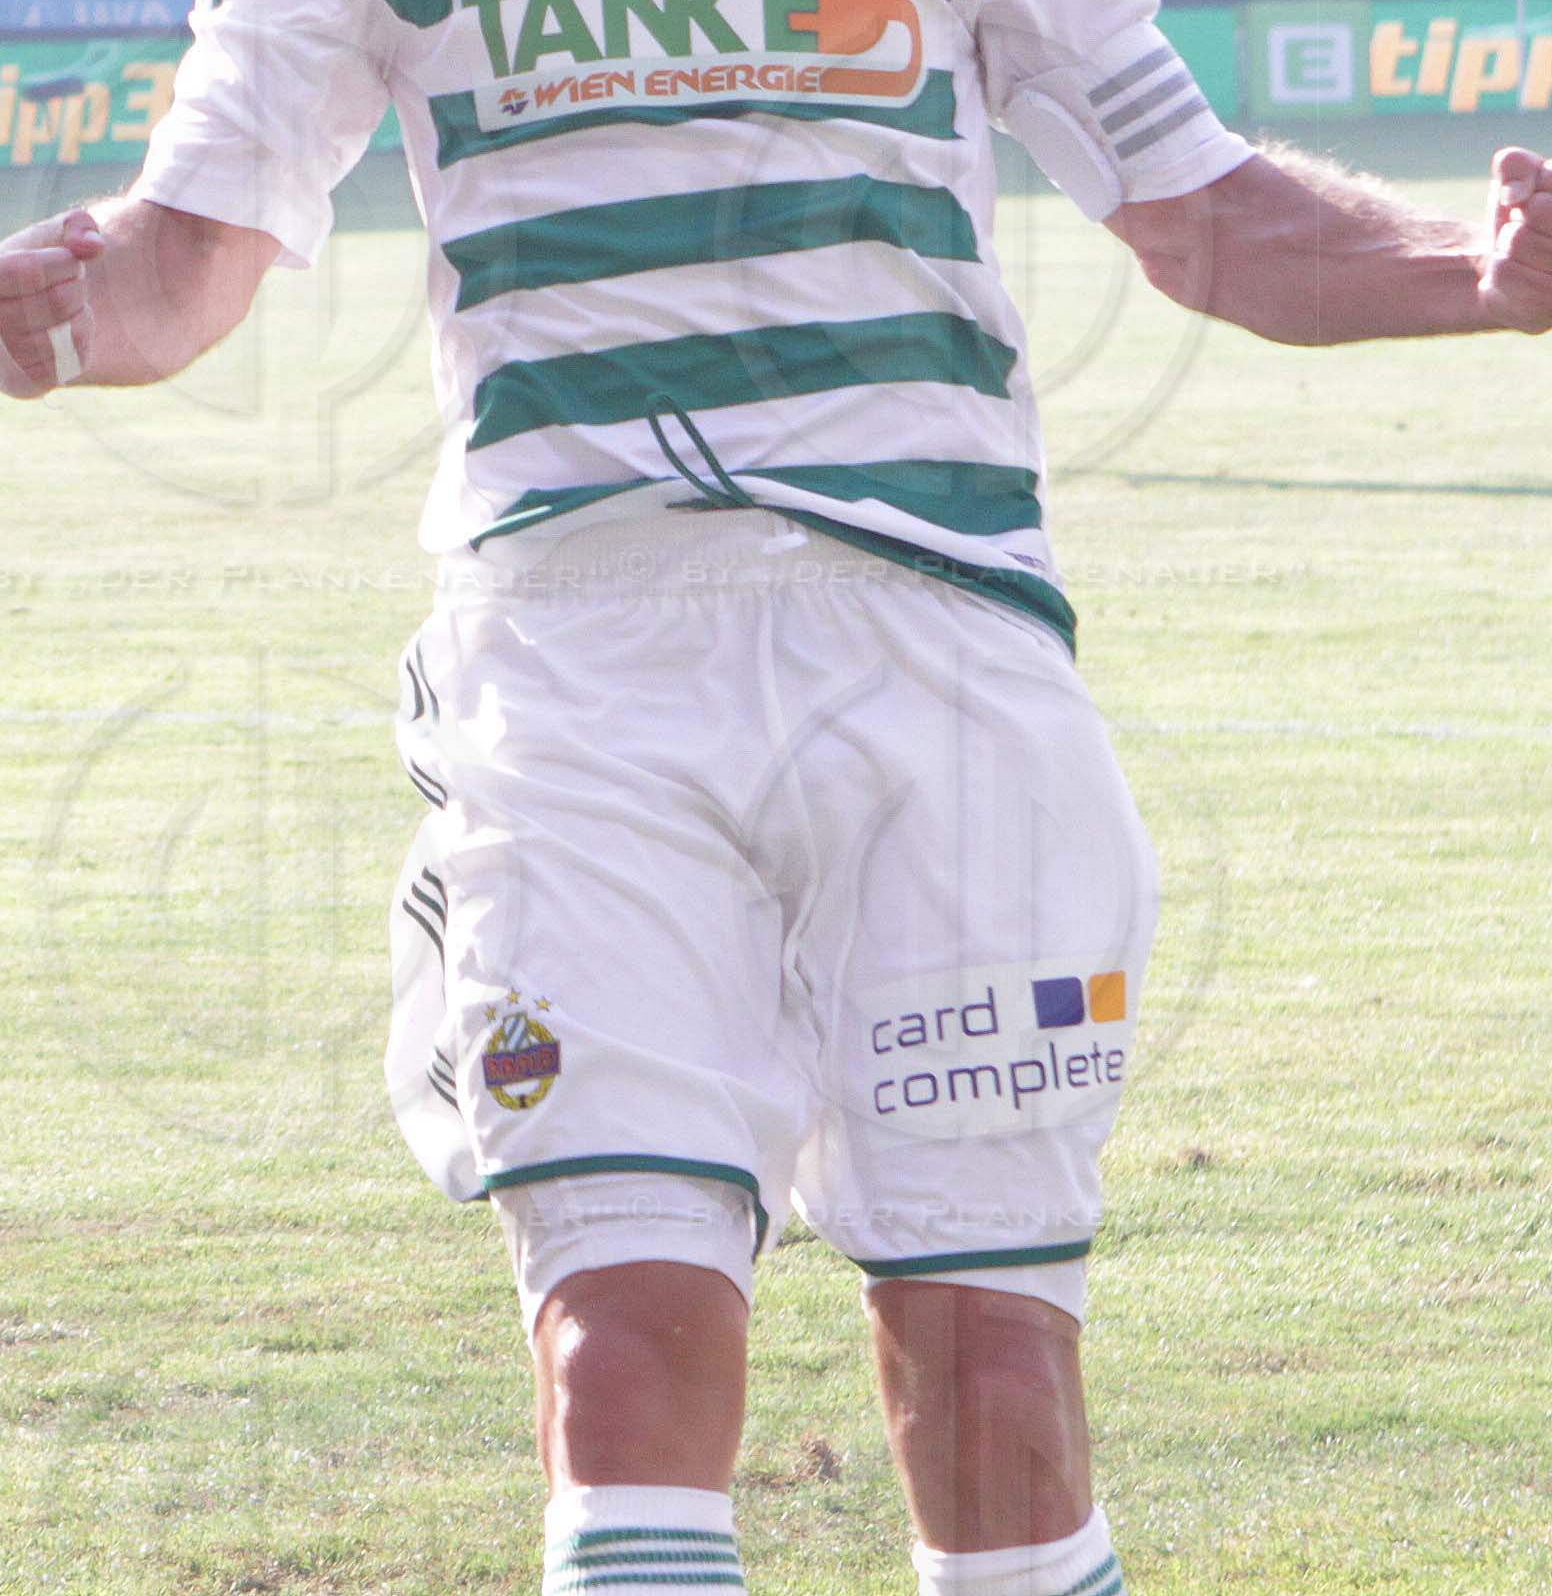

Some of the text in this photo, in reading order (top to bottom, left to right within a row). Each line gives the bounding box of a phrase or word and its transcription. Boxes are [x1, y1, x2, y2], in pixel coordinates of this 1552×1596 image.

[536, 64, 825, 109] WIEN ENERGIE
[872, 986, 997, 1055] card
[872, 1042, 1127, 1116] complete
